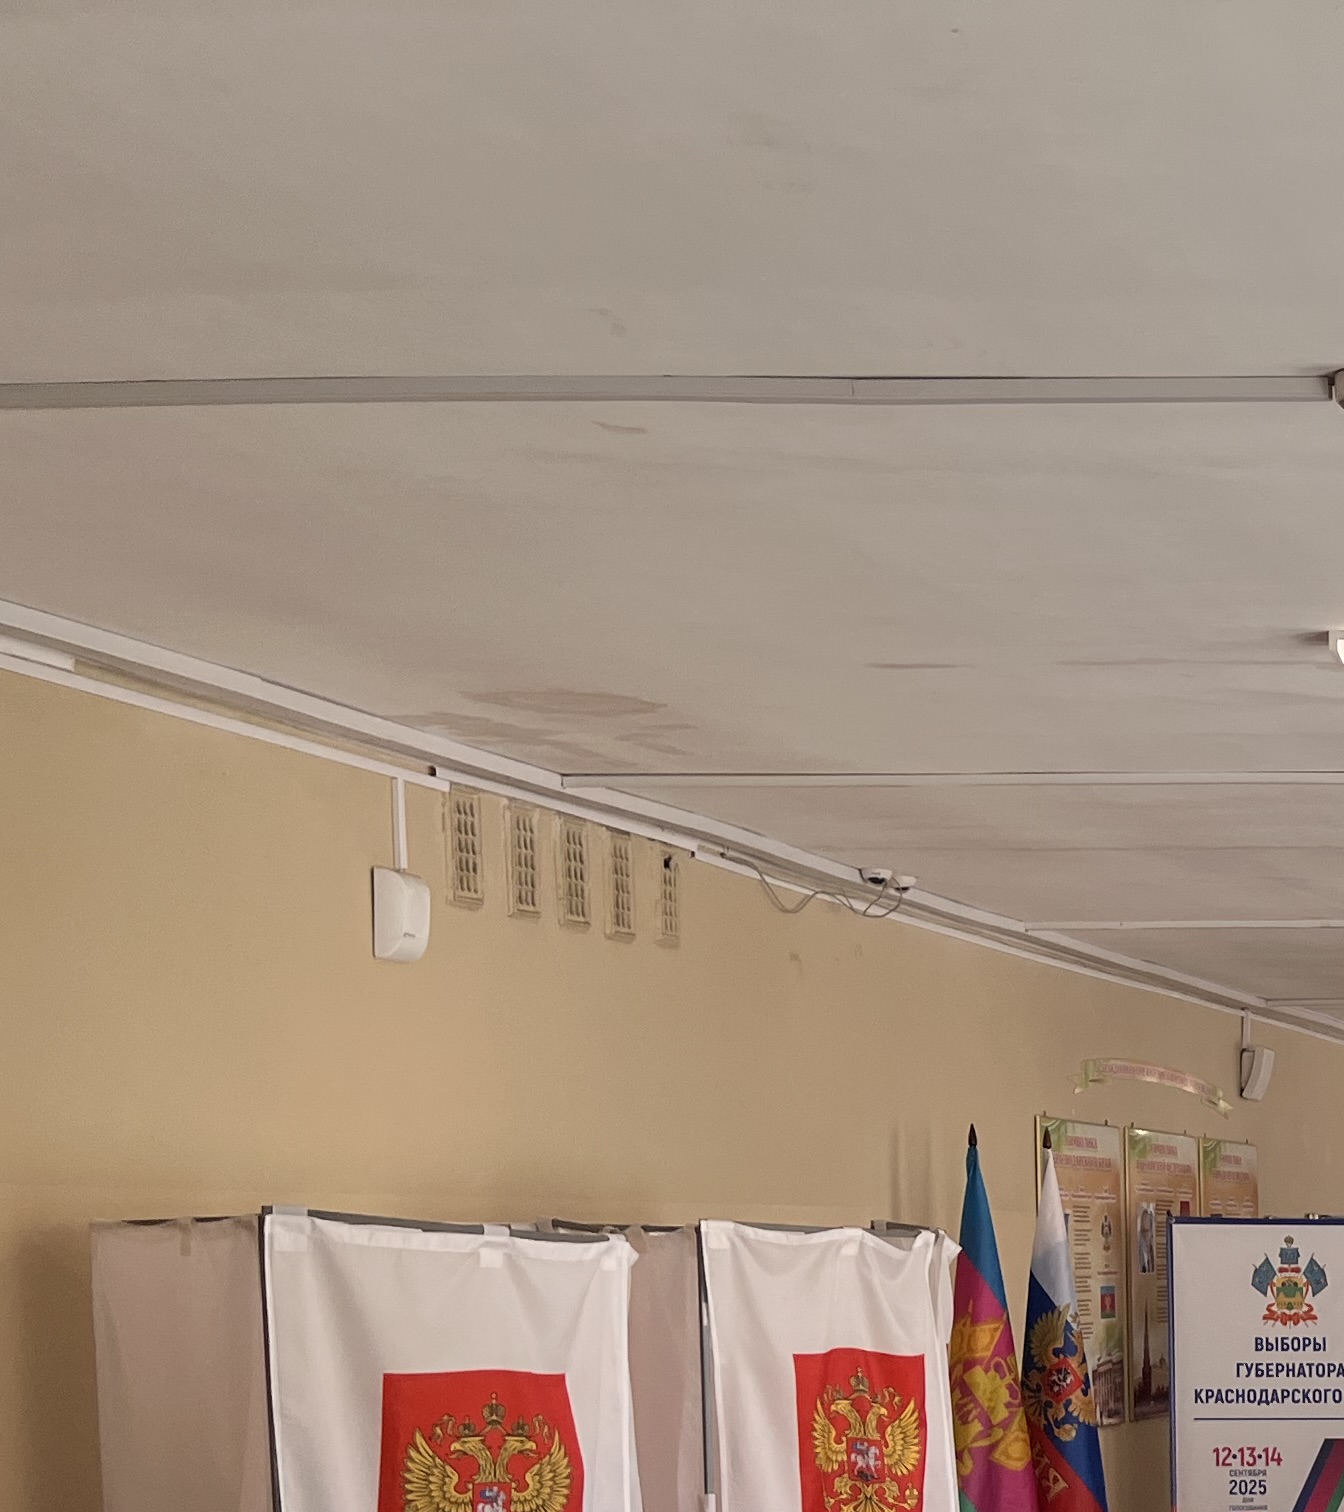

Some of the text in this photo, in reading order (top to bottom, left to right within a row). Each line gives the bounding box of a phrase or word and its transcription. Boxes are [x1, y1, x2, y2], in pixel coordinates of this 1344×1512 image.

[1254, 1337, 1327, 1352] ВЫБОРЫ
[1194, 1388, 1342, 1406] КРАСНОДАРСКОГО
[1212, 1447, 1283, 1467] 12·13·14
[1229, 1469, 1267, 1477] СЕНТЯБРЯ
[1229, 1480, 1267, 1495] 2025
